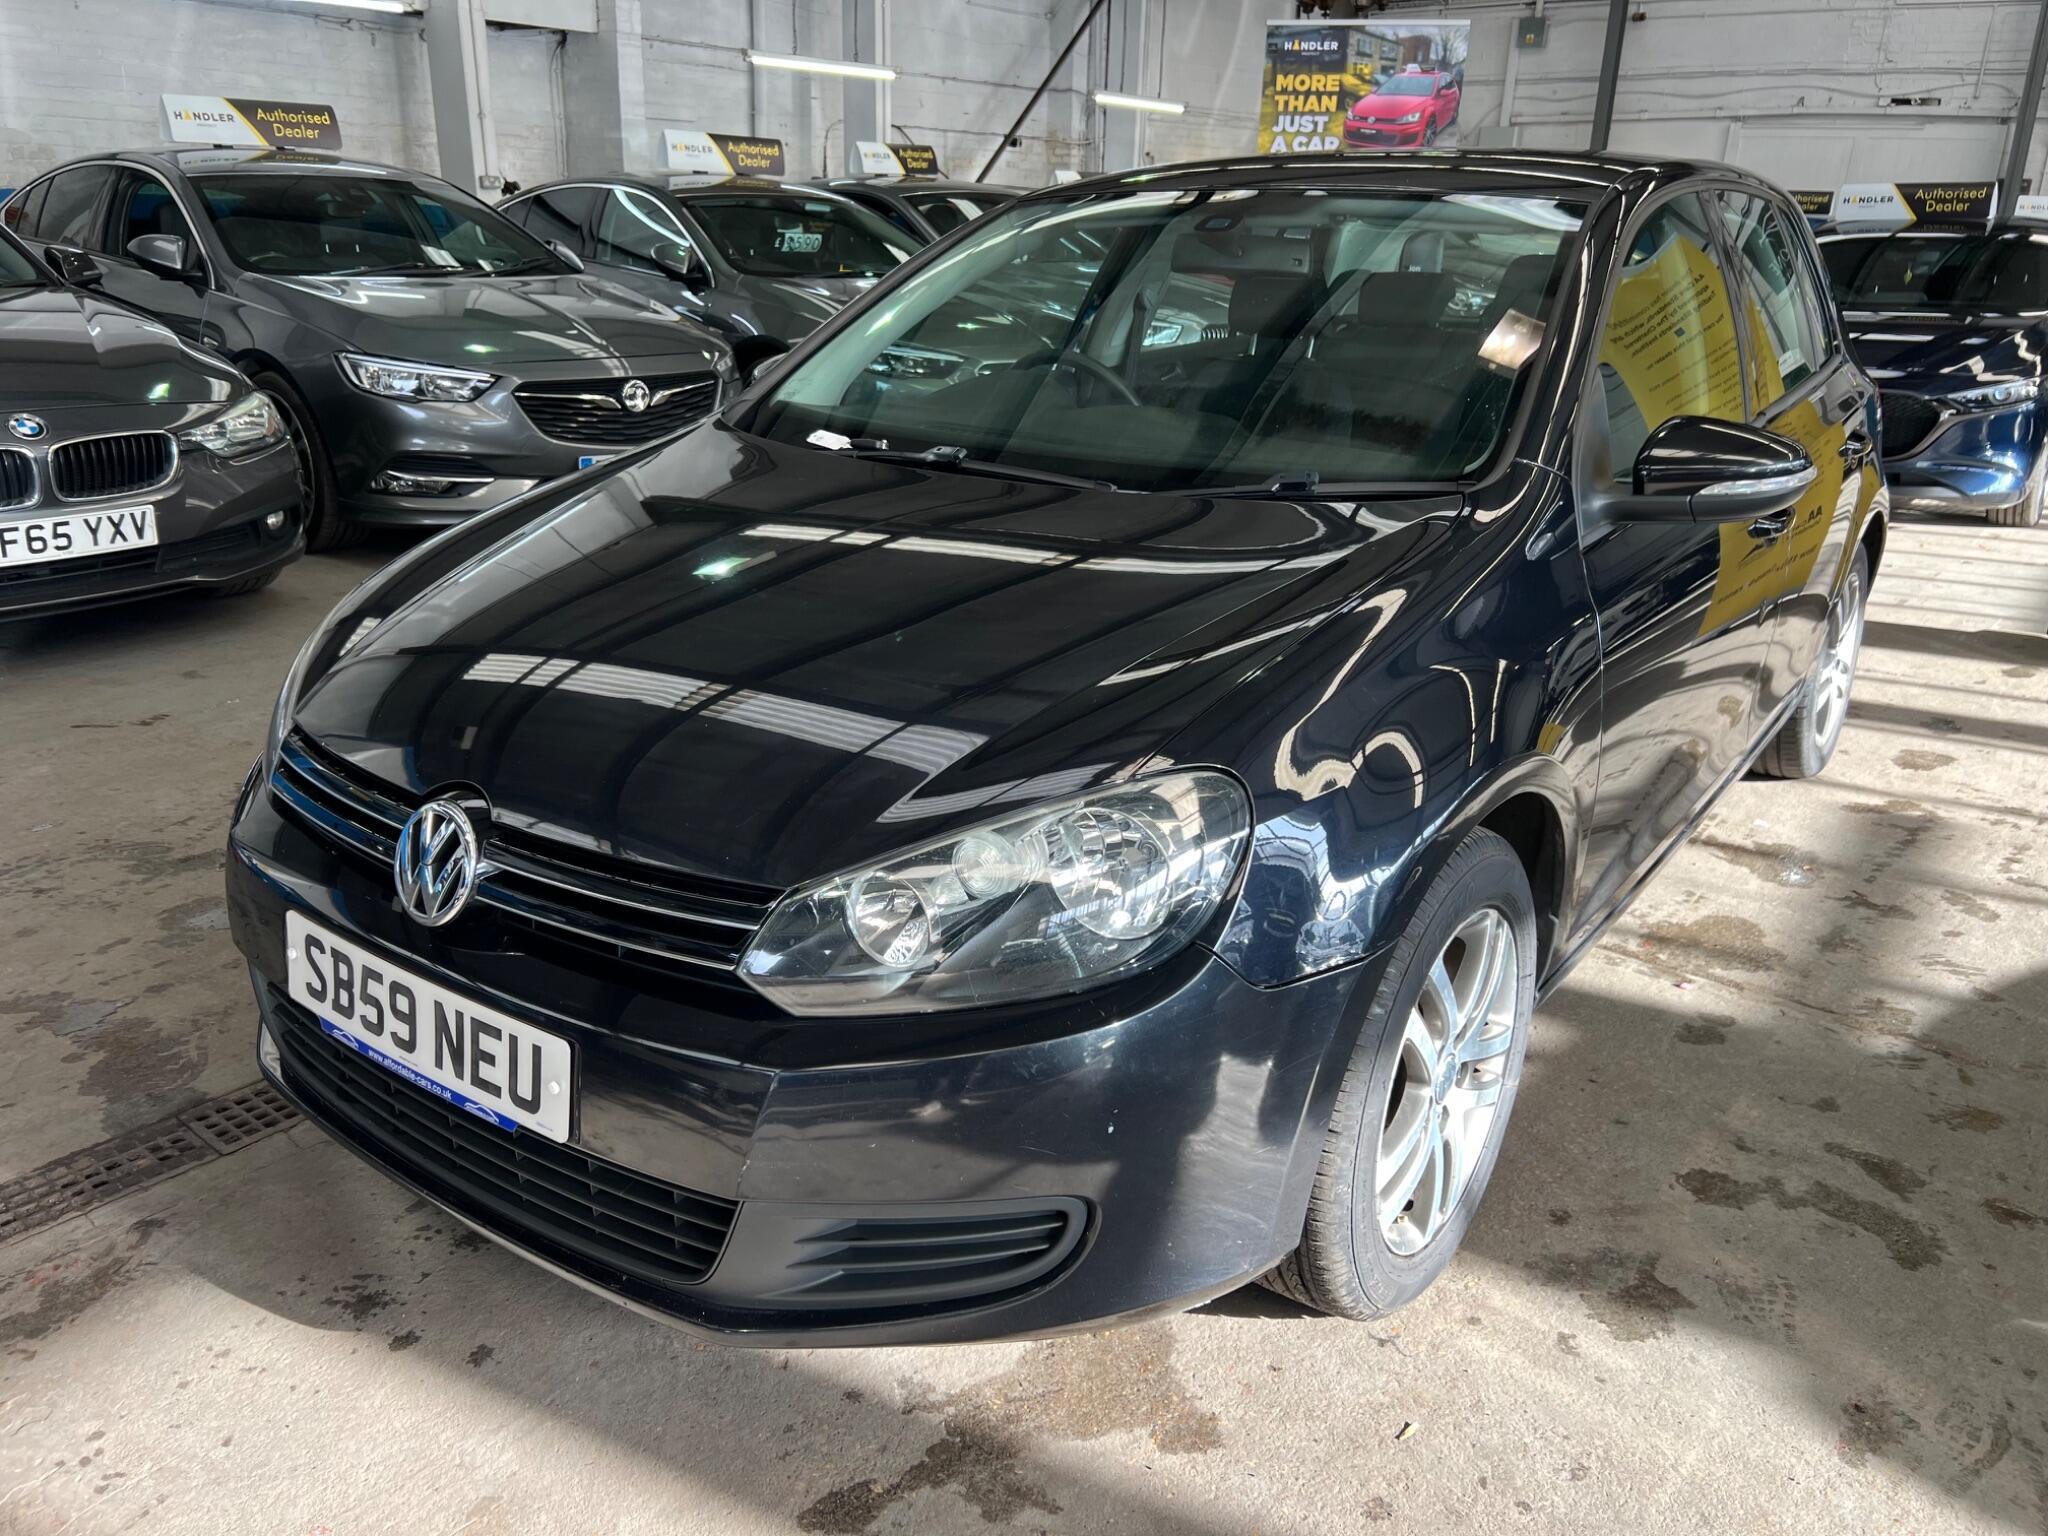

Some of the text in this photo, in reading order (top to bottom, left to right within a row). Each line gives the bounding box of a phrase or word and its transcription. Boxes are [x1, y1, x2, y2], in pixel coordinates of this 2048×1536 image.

[1284, 38, 1339, 51] HANDLER
[1275, 74, 1341, 92] MORE
[1274, 94, 1338, 113] THAN
[173, 109, 235, 123] HANDLER
[256, 107, 331, 126] Authorised
[1272, 114, 1329, 133] JUST
[272, 123, 321, 139] Dealer
[671, 142, 714, 154] HANDLER
[727, 141, 780, 157] Authorised
[1270, 135, 1340, 154] A CAR
[737, 154, 772, 169] Dealer
[1843, 194, 1894, 205] HANDLER
[1914, 186, 1987, 201] Authorised
[1925, 199, 1971, 213] Dealer
[2019, 202, 2048, 210] HANDL
[0, 510, 147, 559] F65 YXV
[304, 933, 543, 1116] SB59 NEU
